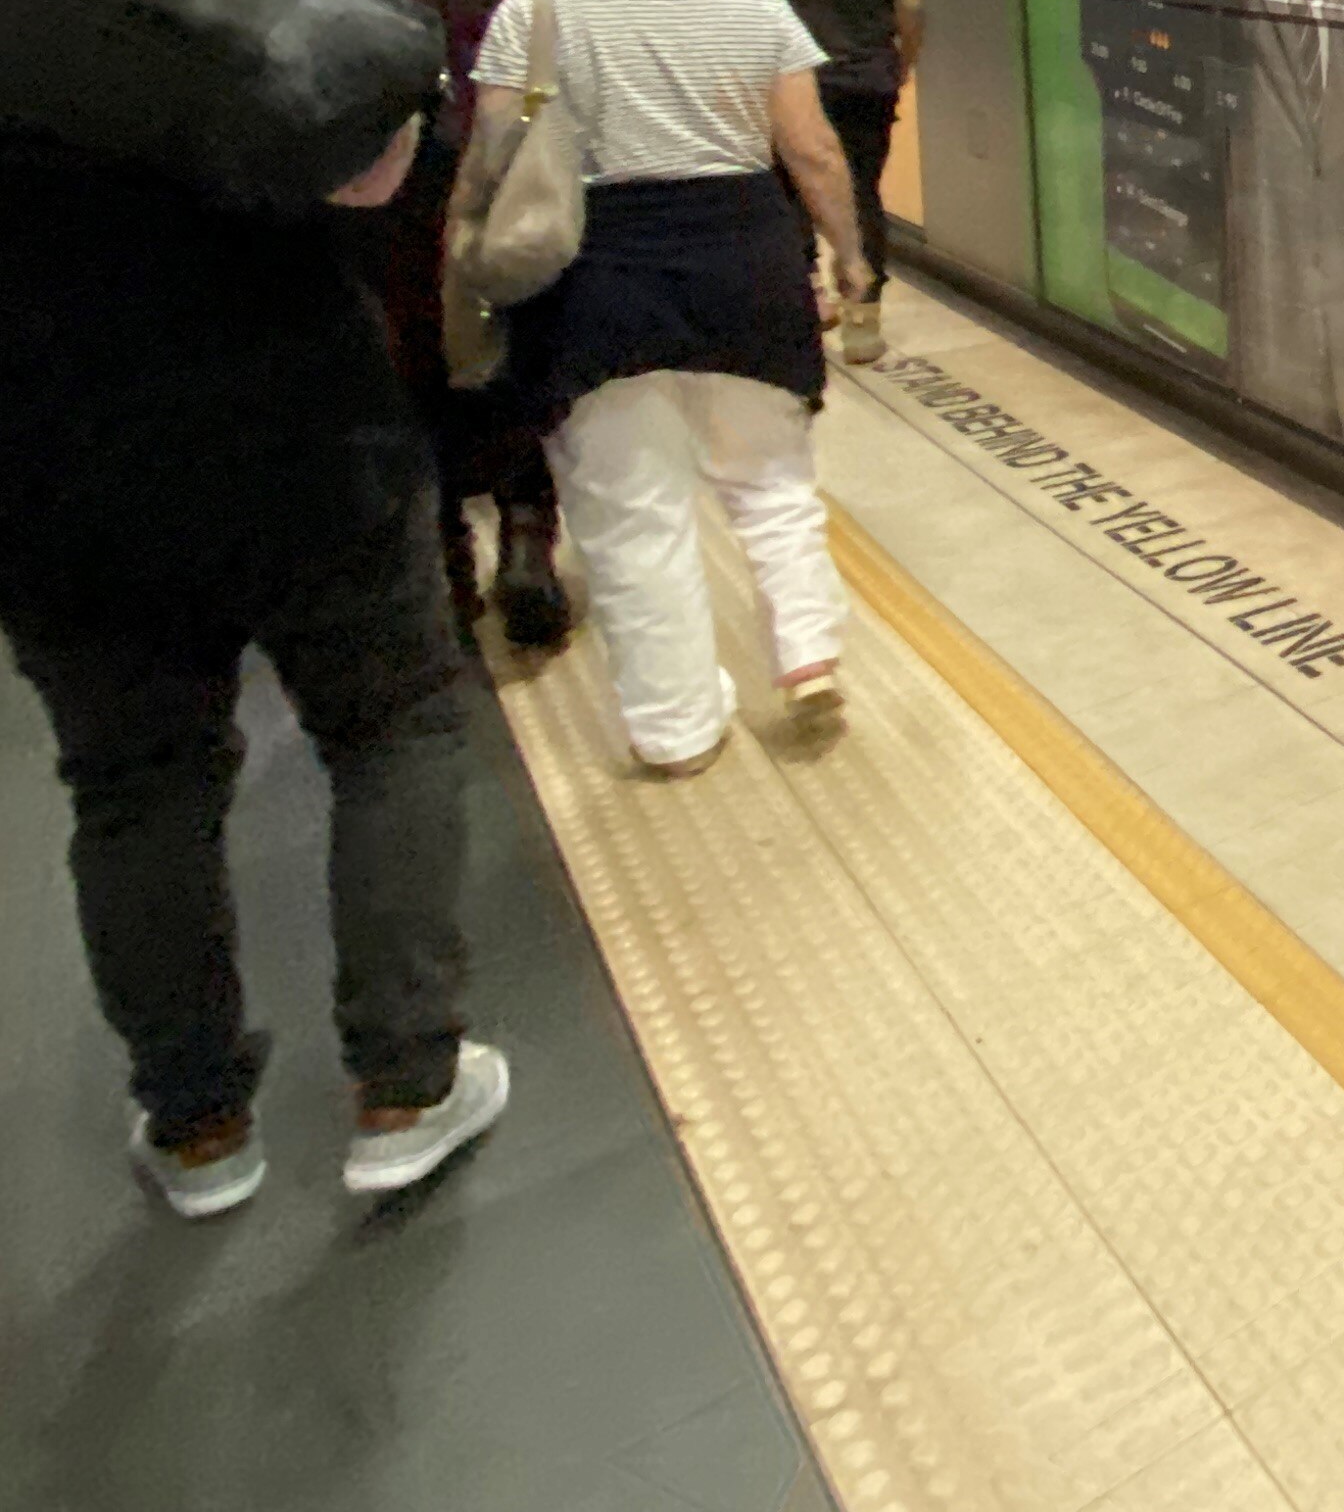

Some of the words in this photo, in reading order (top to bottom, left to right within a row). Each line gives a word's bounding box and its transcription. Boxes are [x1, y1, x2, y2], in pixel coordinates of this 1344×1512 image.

[936, 402, 1070, 468] BEHIND
[1030, 461, 1133, 512] THE
[1089, 501, 1281, 605] YELLOW
